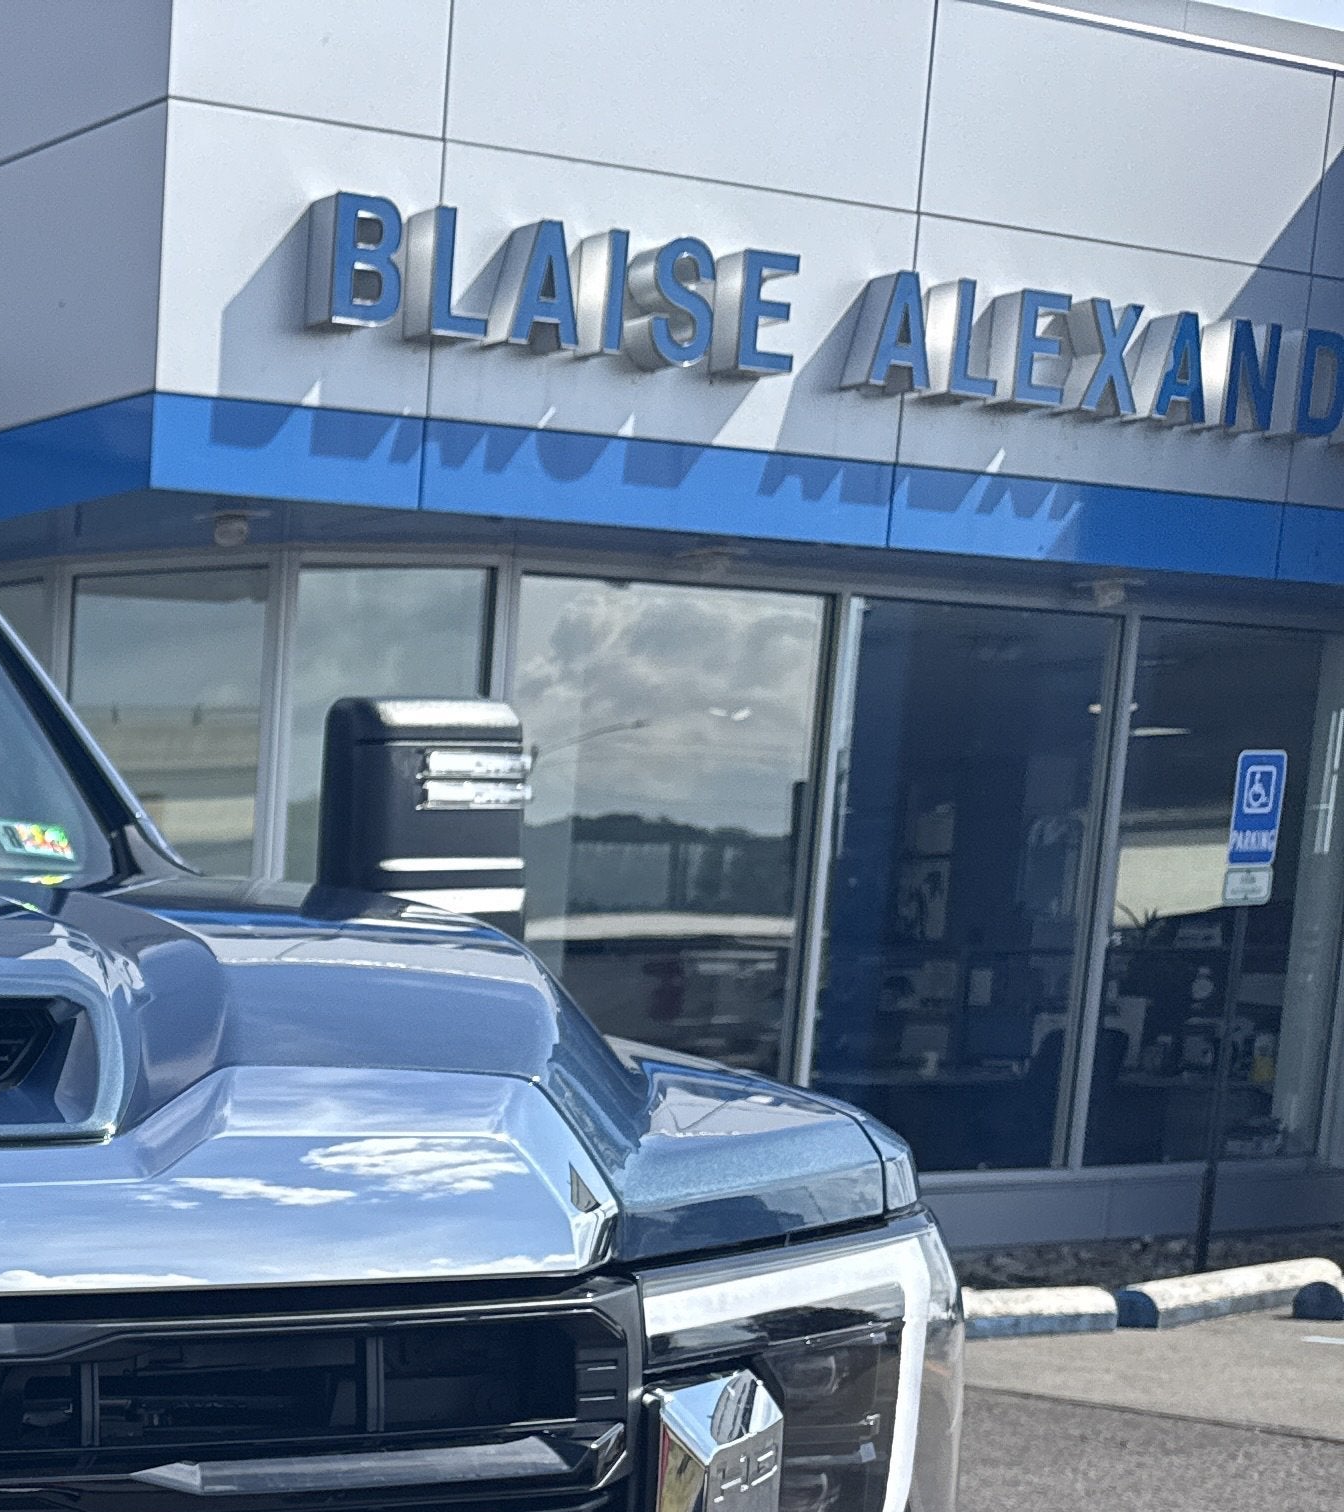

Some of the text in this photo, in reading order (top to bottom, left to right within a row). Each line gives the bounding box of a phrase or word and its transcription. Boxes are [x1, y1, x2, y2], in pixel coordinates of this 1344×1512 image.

[328, 190, 1344, 437] BLAISE ALEXAND
[1230, 830, 1276, 851] PARKING
